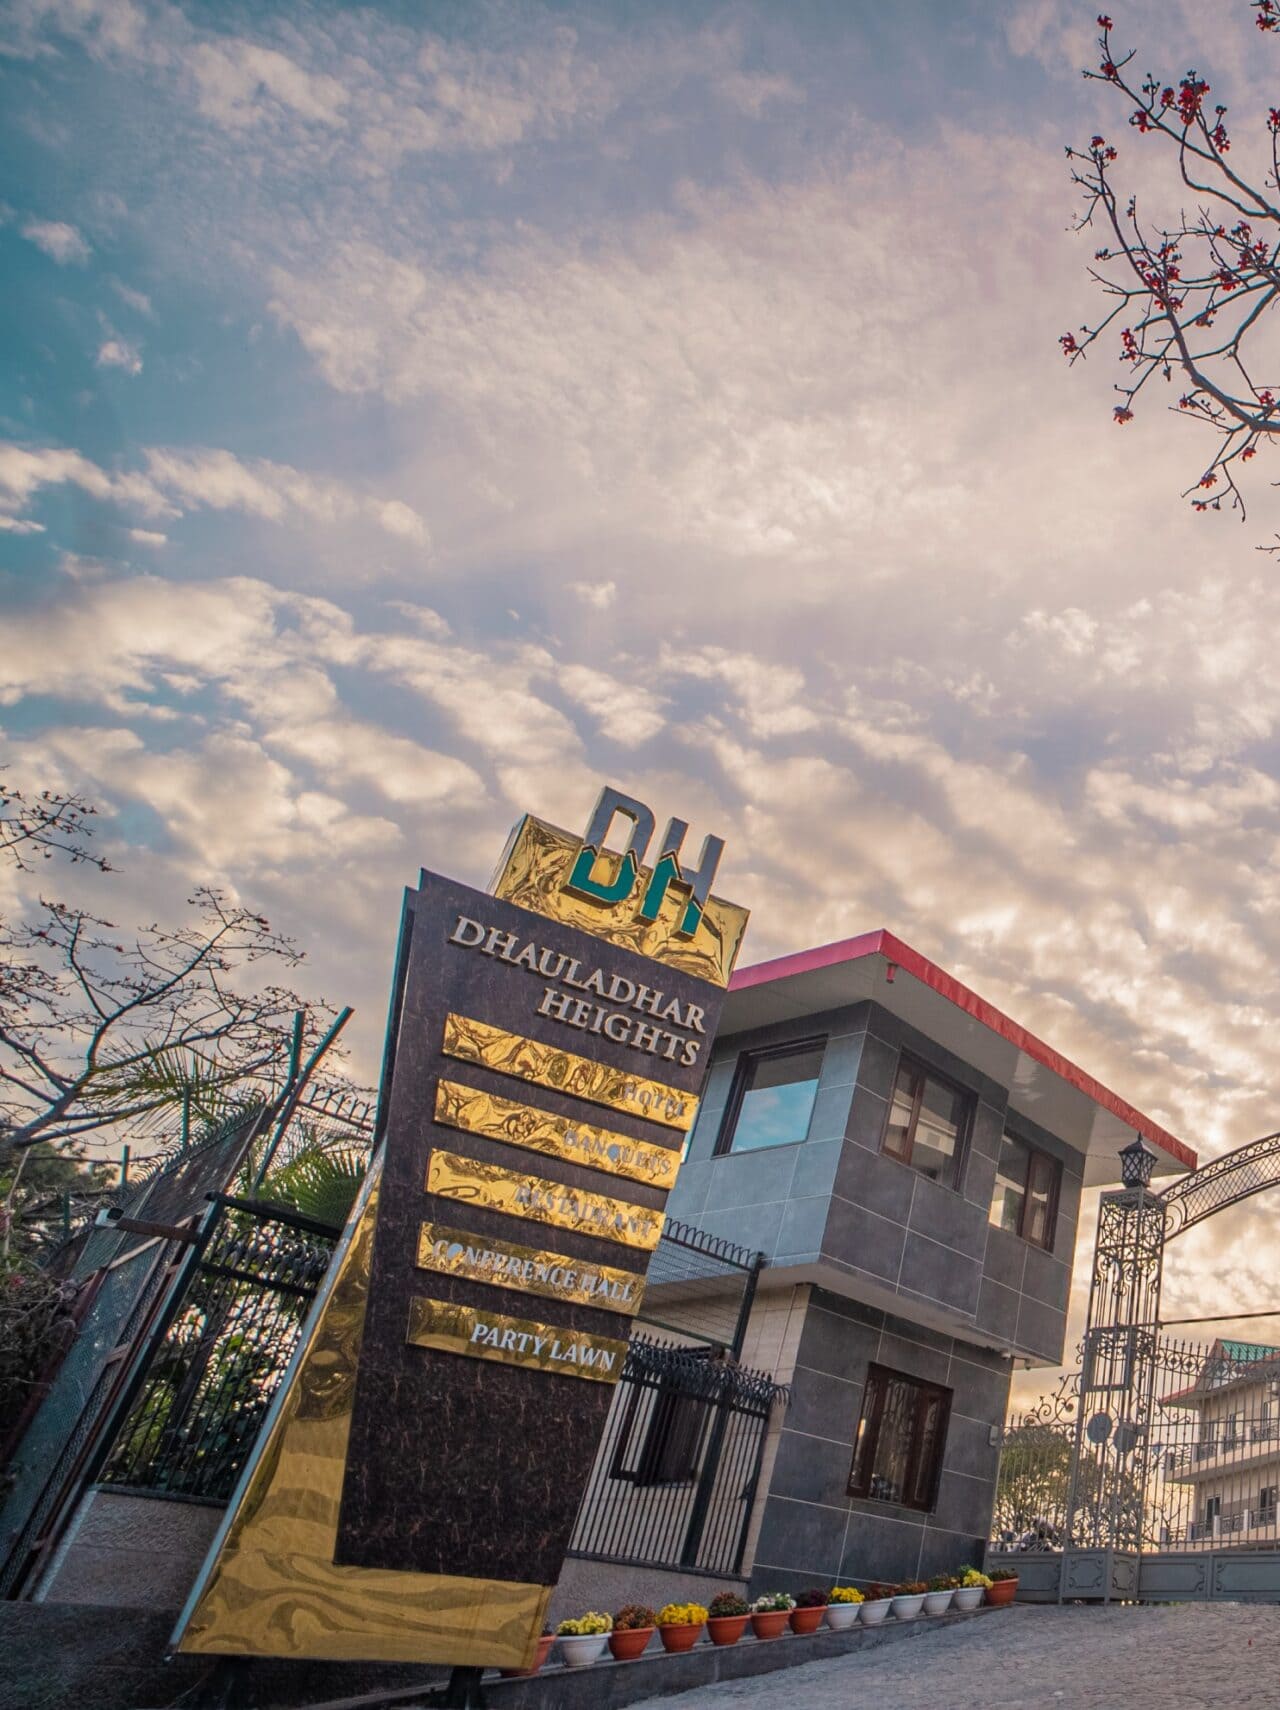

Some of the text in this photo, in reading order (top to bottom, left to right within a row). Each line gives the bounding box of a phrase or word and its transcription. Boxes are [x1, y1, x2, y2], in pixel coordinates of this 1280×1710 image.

[560, 786, 725, 938] DH
[448, 916, 706, 1034] DHAULADHAR
[536, 988, 702, 1068] HEIGHTS
[564, 1129, 672, 1175] BANQUETS
[514, 1185, 653, 1238] RESTAURANT
[432, 1239, 633, 1302] CONFERENCE HALL
[470, 1323, 617, 1370] PARTY LAWN
